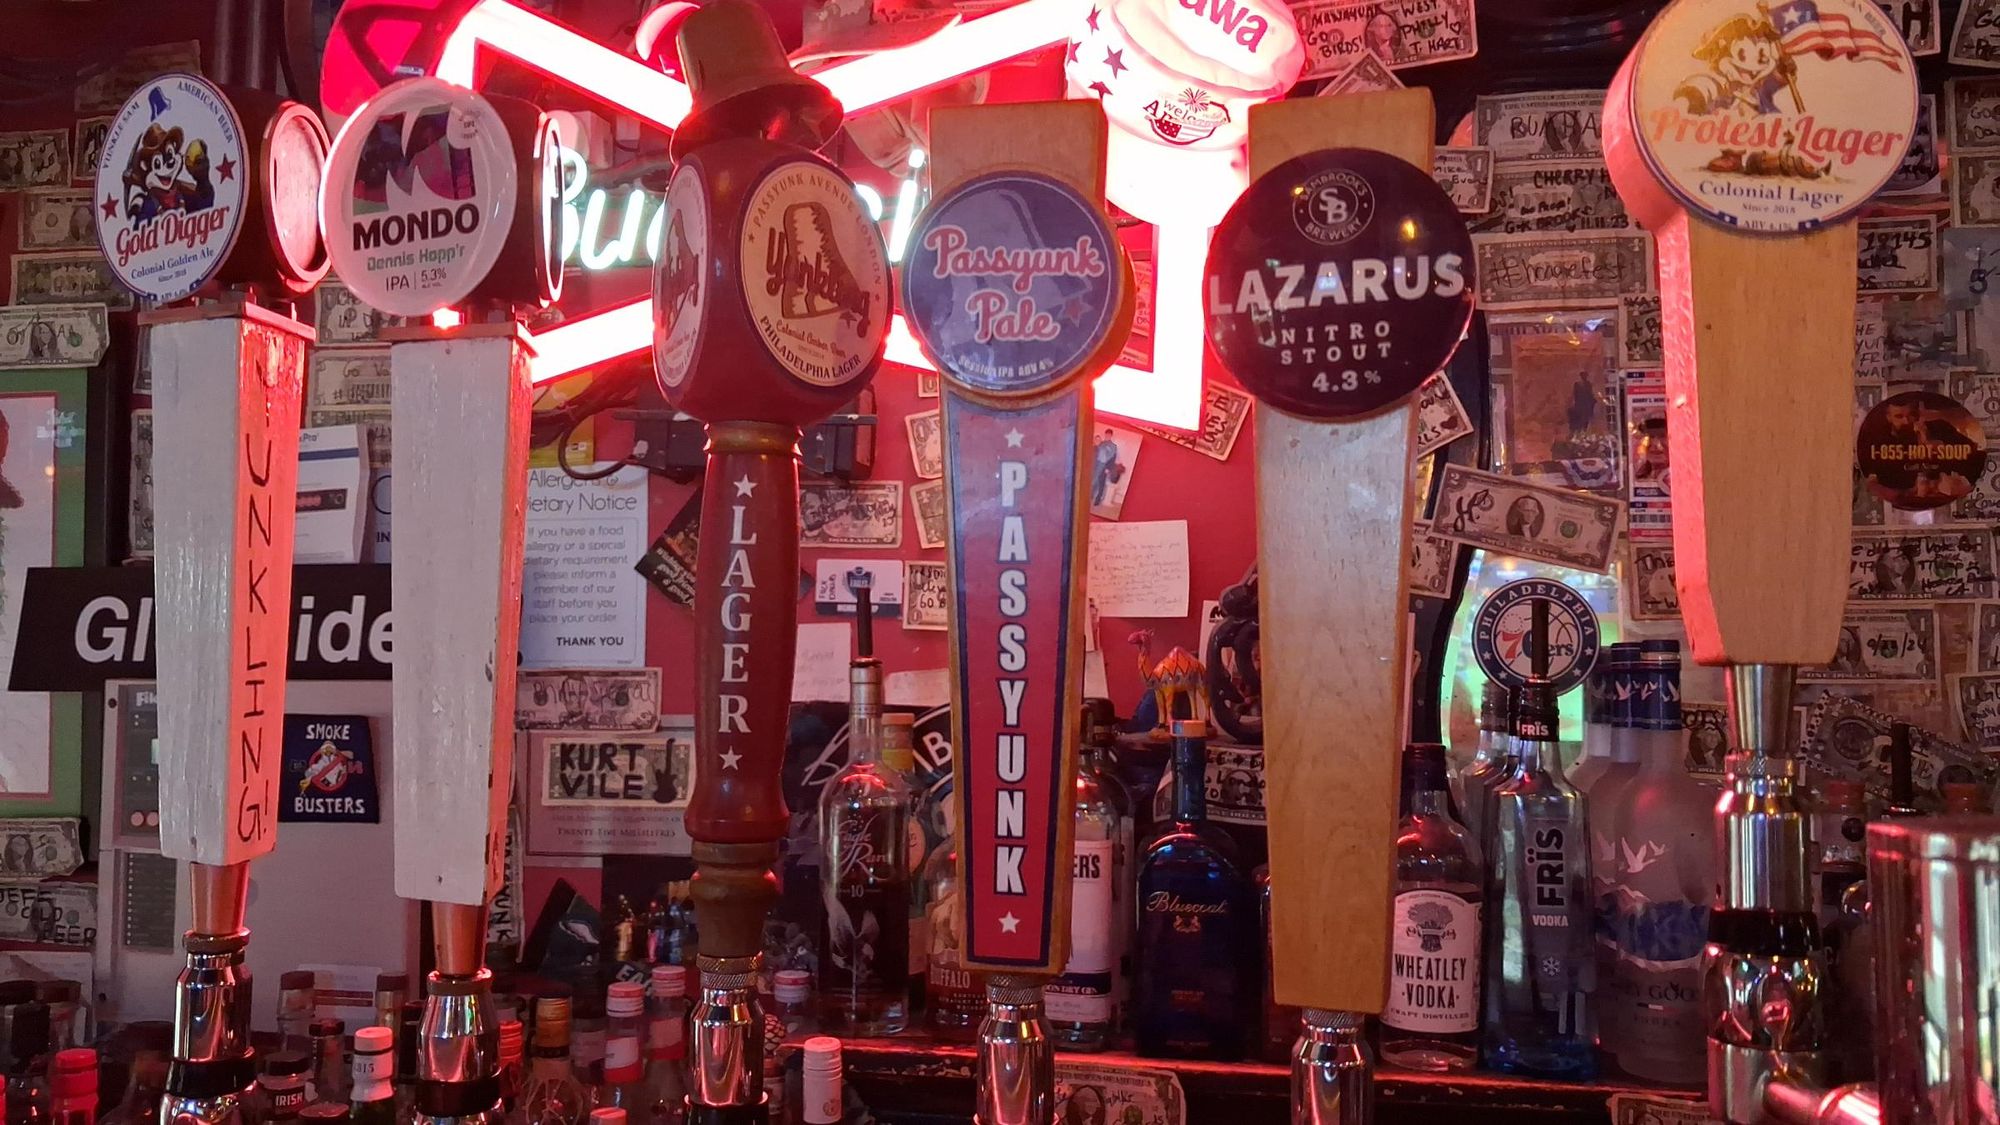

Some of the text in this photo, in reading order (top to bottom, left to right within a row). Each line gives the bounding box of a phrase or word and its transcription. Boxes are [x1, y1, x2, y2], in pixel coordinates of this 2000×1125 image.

[177, 80, 220, 119] AMERICAN
[1650, 105, 1903, 166] Protest Lager
[753, 172, 805, 229] PASSYUNK
[1699, 180, 1844, 210] Colonial Lager
[116, 206, 231, 267] Gold Digger
[352, 203, 480, 251] MONDO
[1304, 216, 1363, 241] BREWERY
[131, 260, 166, 280] Colonial
[167, 252, 199, 271] Golden
[367, 250, 415, 271] Dennis
[924, 225, 1105, 294] Passyunk
[386, 274, 410, 292] IPA
[421, 267, 447, 283] 5.3%
[1209, 254, 1465, 316] LAZARUS
[965, 288, 1061, 344] Pale
[760, 314, 863, 379] PHILADELPHIA LAGER
[1281, 320, 1391, 346] NITRO
[1281, 342, 1392, 366] STOUT
[527, 492, 638, 514] ietary Notice
[534, 583, 580, 595] member
[558, 598, 595, 610] before
[1478, 584, 1596, 641] PHILADELPHIA
[74, 595, 392, 664] Glide
[718, 504, 759, 734] LAGER
[556, 636, 625, 647] THANK YOU
[994, 460, 1029, 897] PASSYUNK
[305, 723, 351, 740] SMOKE
[559, 742, 646, 772] KURT
[558, 772, 644, 800] VILE
[294, 796, 367, 814] BUSTERS
[1145, 890, 1229, 914] Bluecoat
[1532, 914, 1569, 927] VODKA
[1394, 953, 1467, 981] WHEATLEY
[1405, 983, 1456, 1009] VODKA
